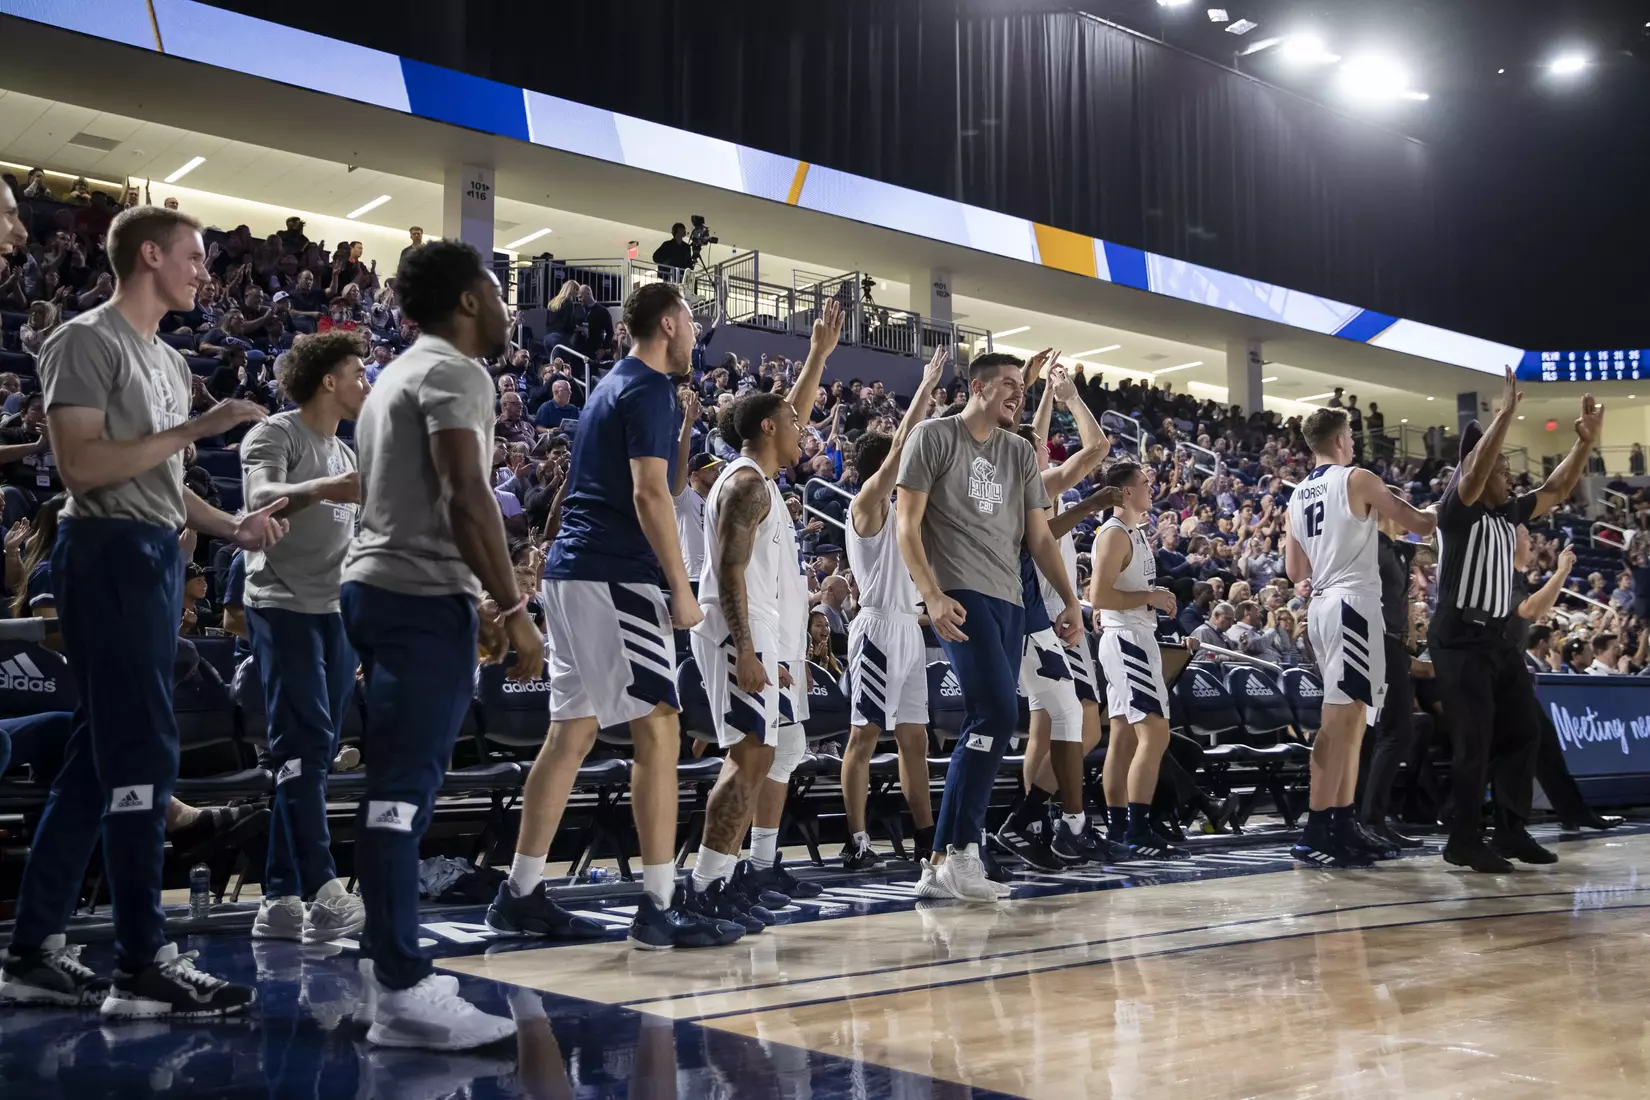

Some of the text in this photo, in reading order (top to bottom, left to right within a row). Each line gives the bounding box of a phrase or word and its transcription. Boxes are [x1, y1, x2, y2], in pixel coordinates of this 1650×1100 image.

[470, 181, 485, 191] 101
[470, 190, 487, 201] 116
[979, 500, 993, 512] CBU
[333, 508, 350, 521] CBU
[1304, 500, 1324, 537] 12
[0, 674, 56, 692] didas
[1192, 687, 1220, 697] adidas
[1246, 687, 1274, 696] adidas
[1550, 702, 1629, 755] Meeting
